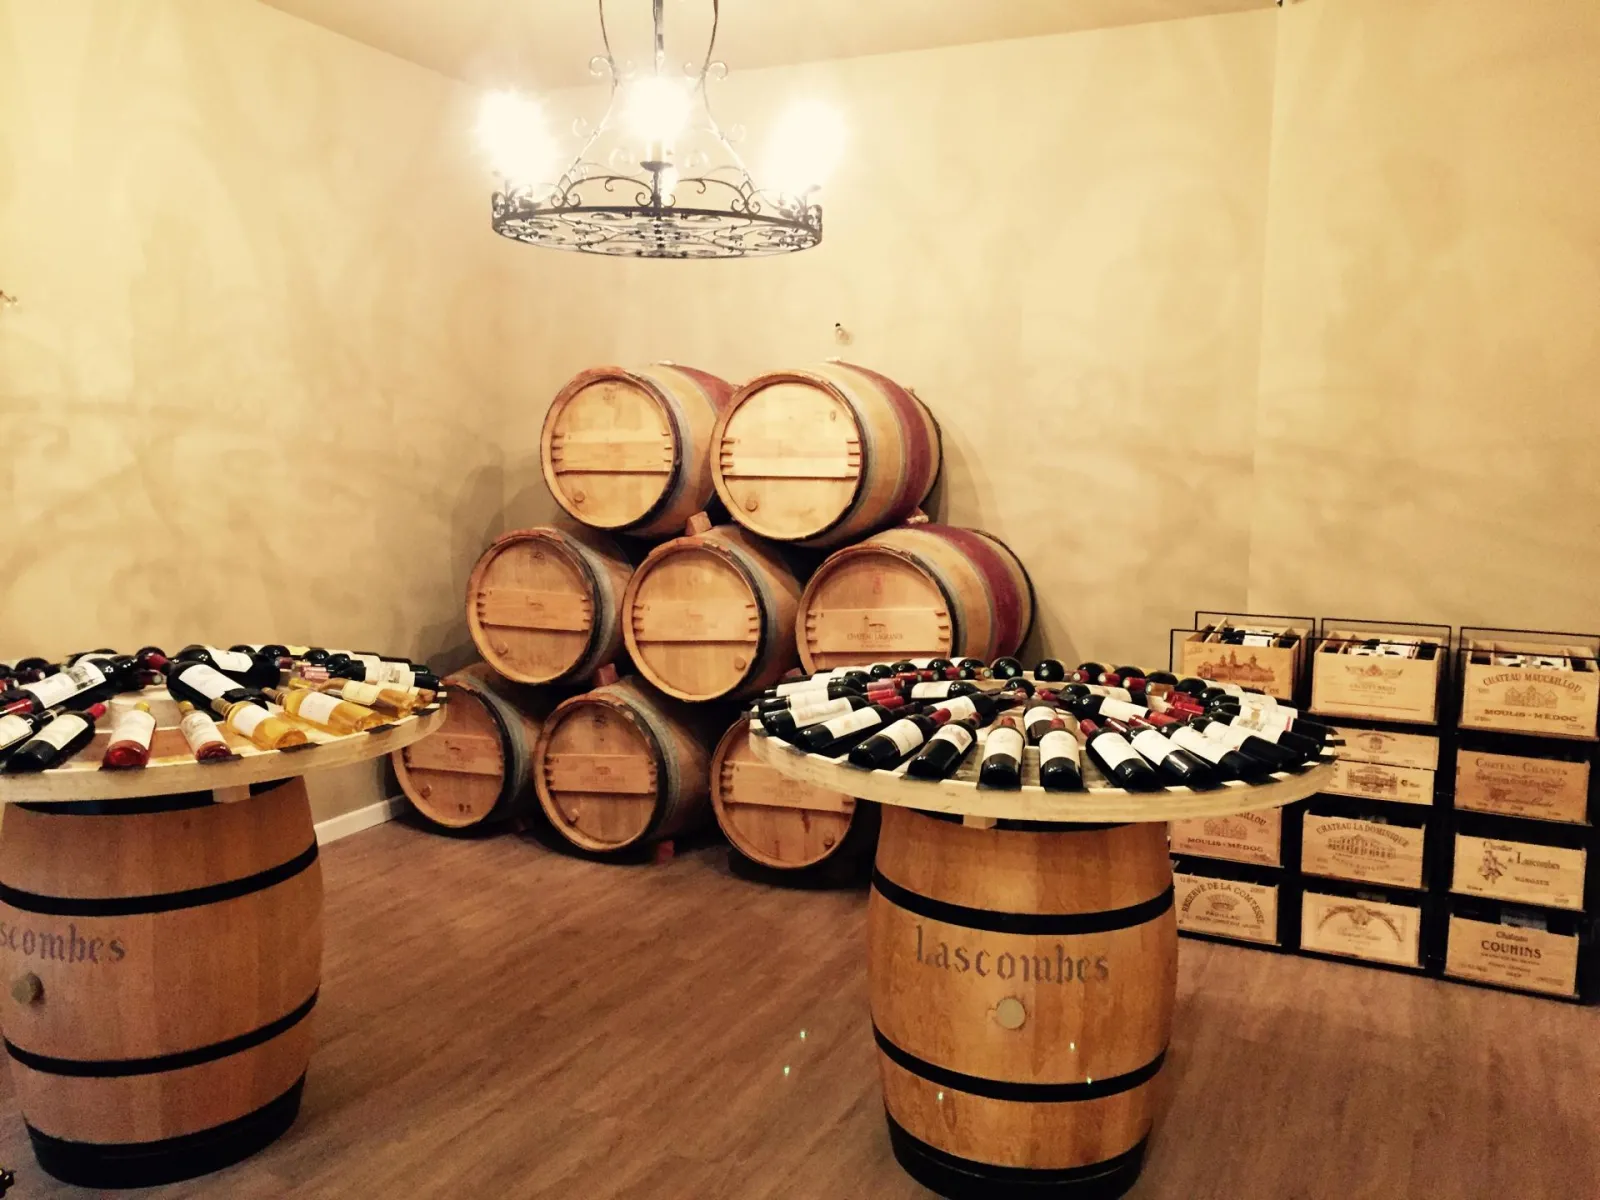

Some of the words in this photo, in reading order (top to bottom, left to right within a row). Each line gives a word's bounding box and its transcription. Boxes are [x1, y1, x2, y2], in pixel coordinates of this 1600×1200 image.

[1364, 824, 1410, 848] DOMINIQUE
[1207, 881, 1219, 890] DE
[1220, 882, 1232, 891] LA
[1233, 886, 1265, 925] COMTESSE
[1481, 940, 1542, 959] COUHINS
